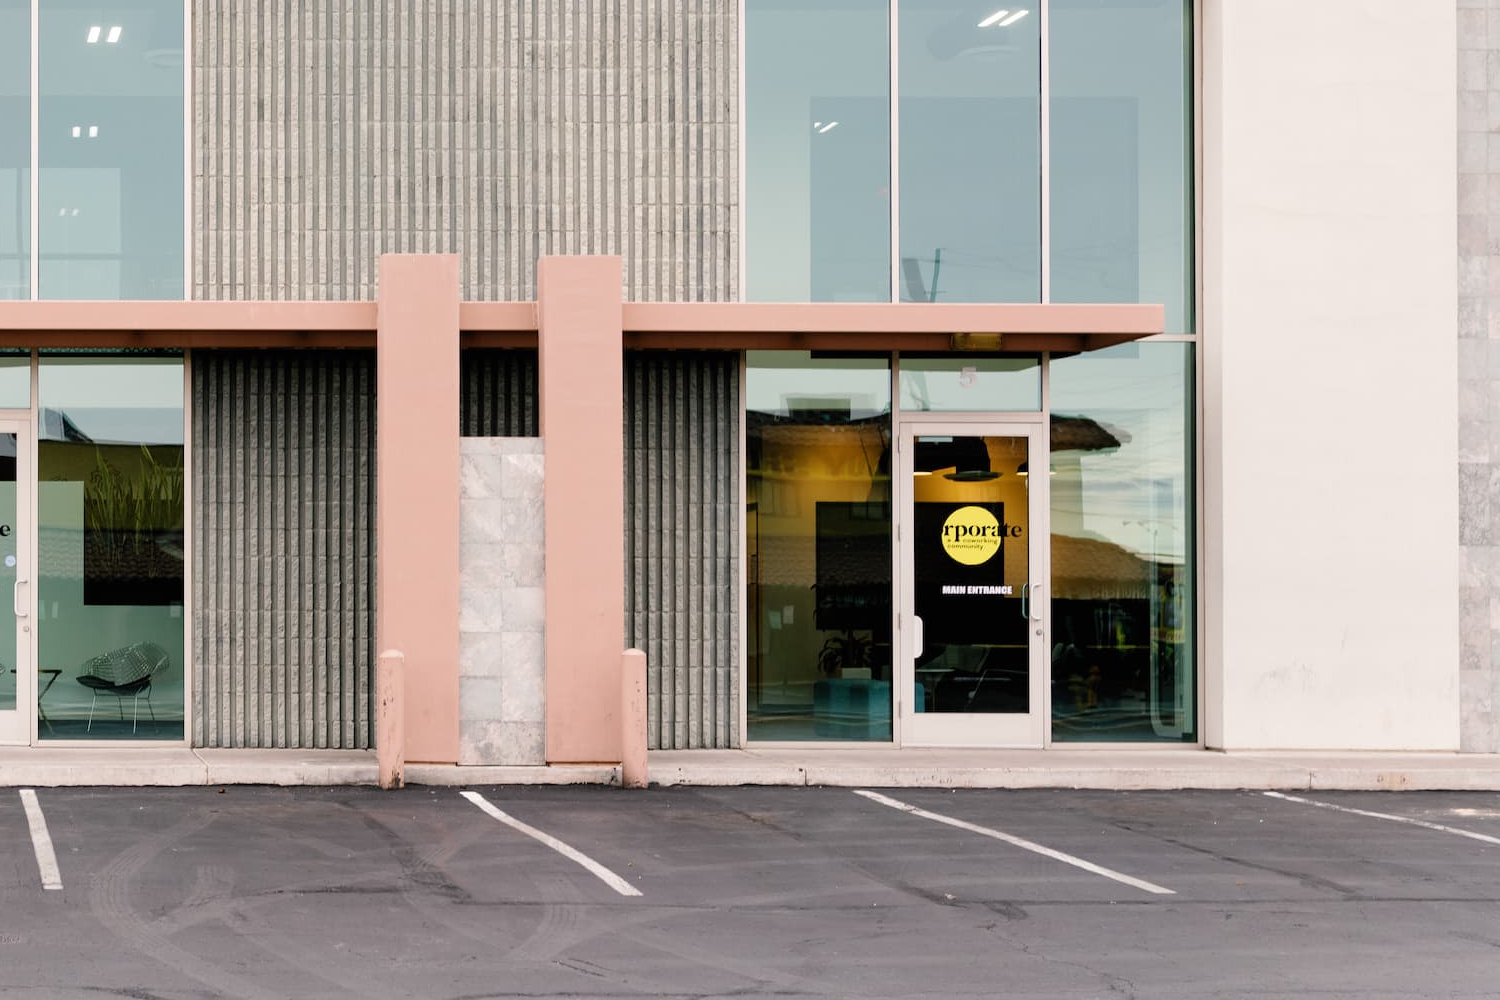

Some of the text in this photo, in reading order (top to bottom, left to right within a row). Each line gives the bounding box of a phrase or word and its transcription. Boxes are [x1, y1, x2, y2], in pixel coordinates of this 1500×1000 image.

[960, 366, 978, 388] 5
[942, 585, 1013, 595] MAIN ENTRANCE
